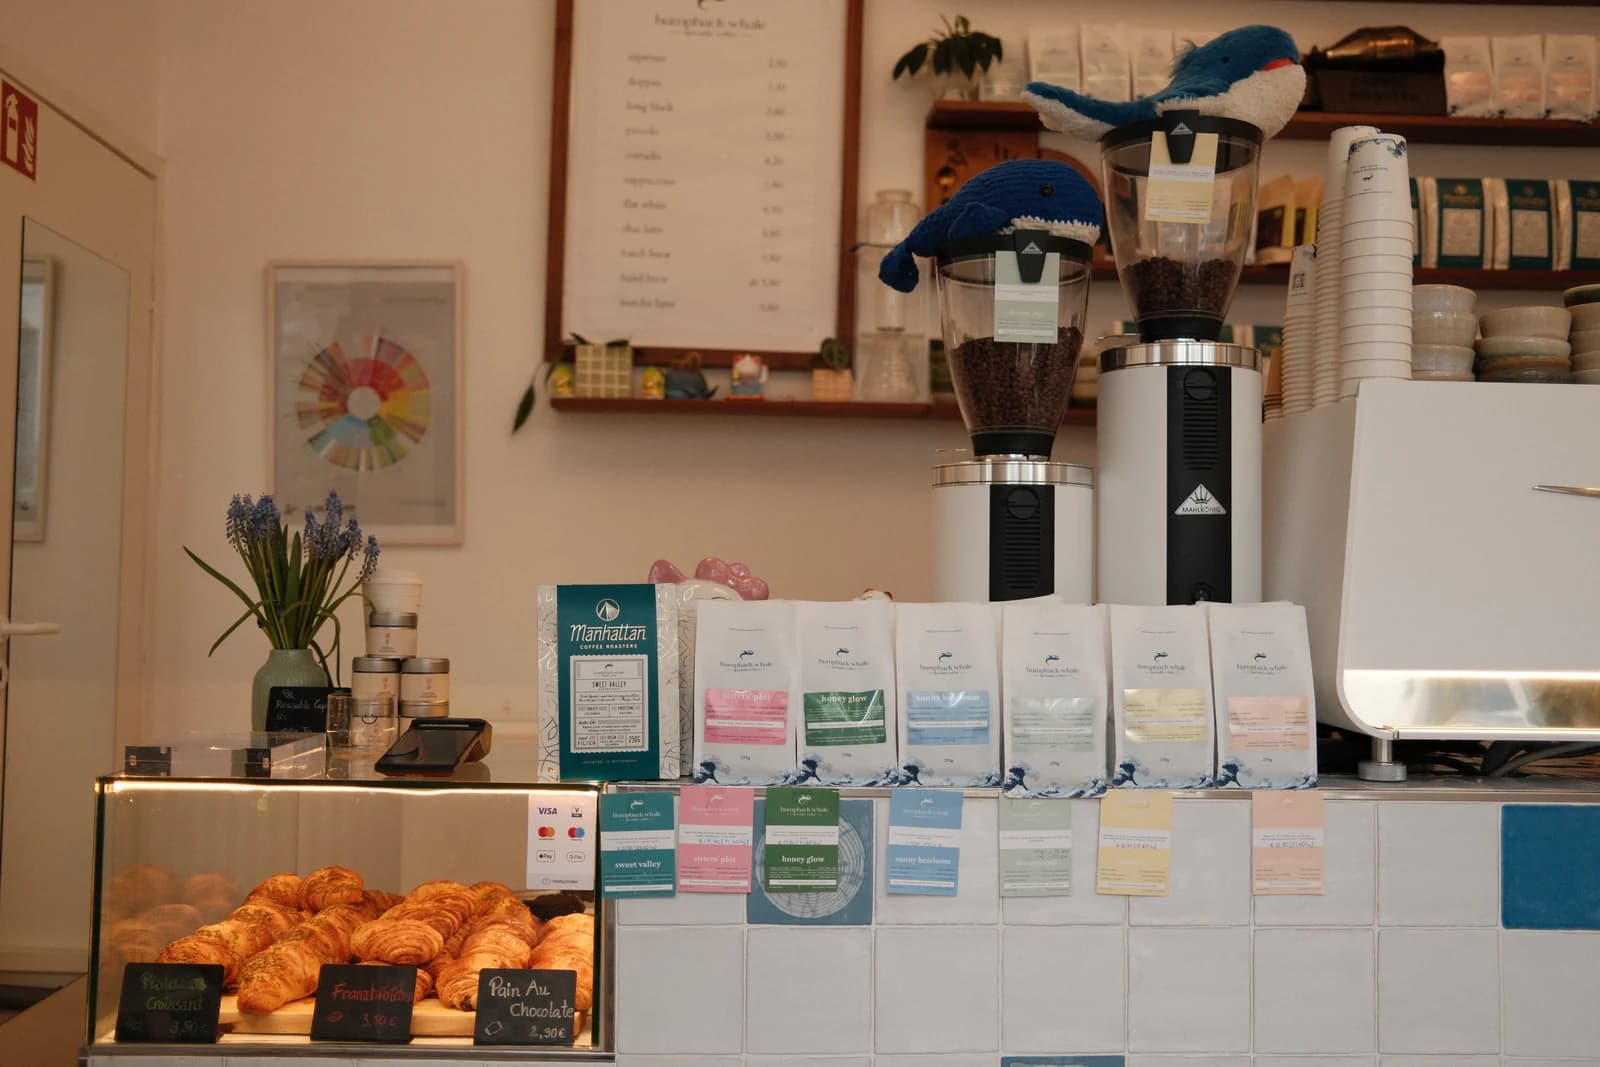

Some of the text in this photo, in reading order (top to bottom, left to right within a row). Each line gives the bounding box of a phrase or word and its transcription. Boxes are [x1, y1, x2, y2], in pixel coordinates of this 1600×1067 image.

[570, 624, 647, 642] Manhattan
[821, 694, 868, 703] honey glow
[538, 807, 558, 815] VISA
[614, 860, 662, 869] sweet valley
[781, 855, 825, 864] honey glow
[488, 975, 551, 998] Pain Au
[509, 999, 575, 1018] Chocolate
[528, 1024, 567, 1039] 2,90€
